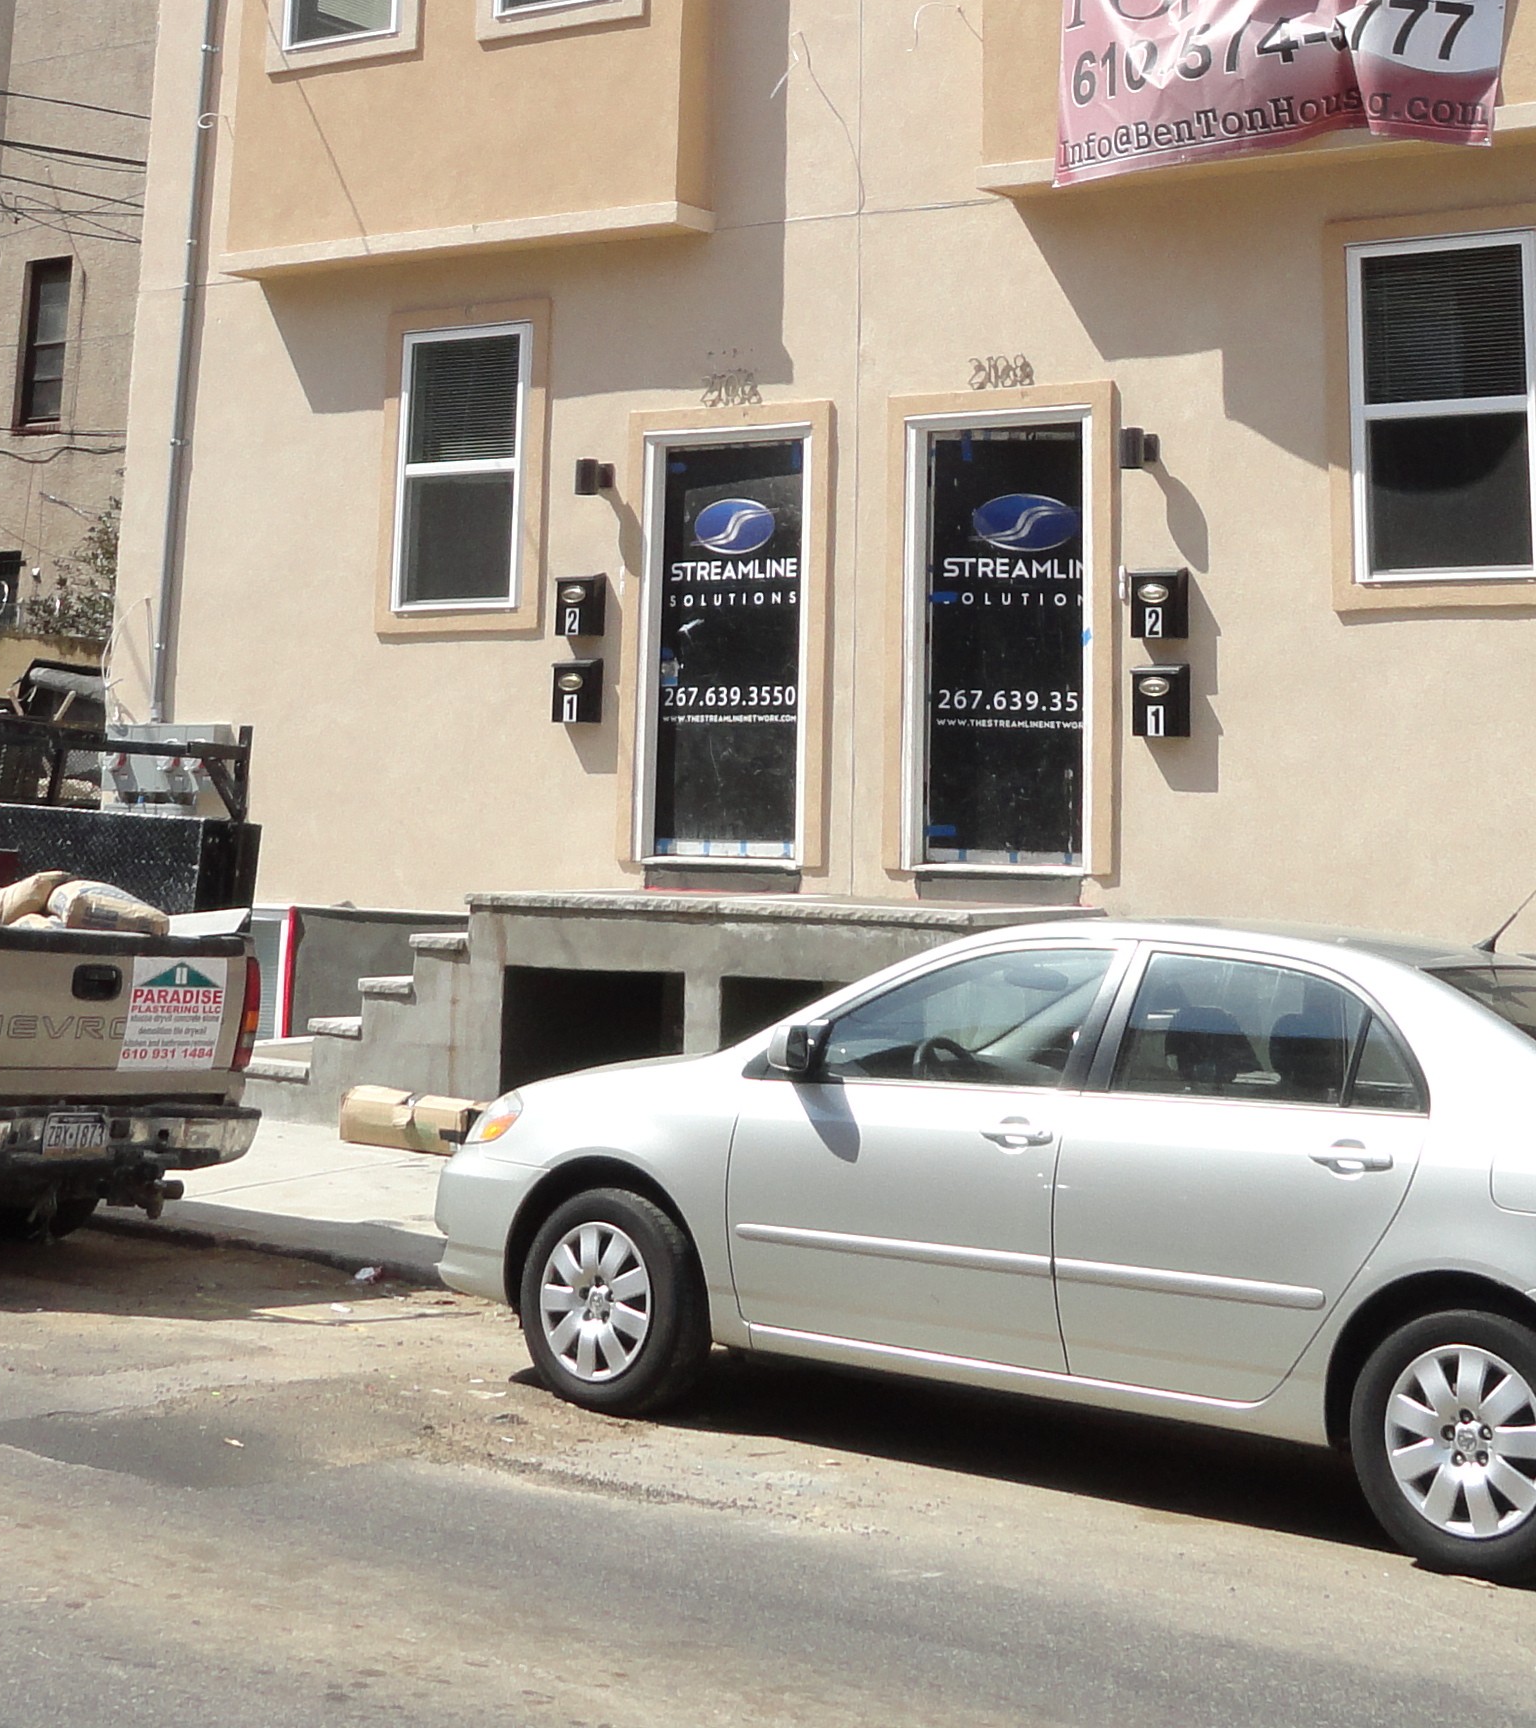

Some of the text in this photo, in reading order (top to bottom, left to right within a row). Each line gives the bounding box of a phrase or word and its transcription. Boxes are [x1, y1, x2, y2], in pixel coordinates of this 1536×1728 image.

[671, 557, 798, 582] STREAMLINE
[669, 591, 797, 608] SOLUTIONS
[943, 592, 1084, 607] OLUTION
[567, 609, 578, 633] 2
[1147, 609, 1160, 636] 2
[664, 685, 796, 707] 267.639.3550
[566, 696, 574, 720] 1
[1150, 707, 1160, 735] 1
[132, 988, 224, 1005] PARADISE
[130, 1005, 222, 1015] PLASTERING LLC
[122, 1047, 213, 1060] 610 931 1484
